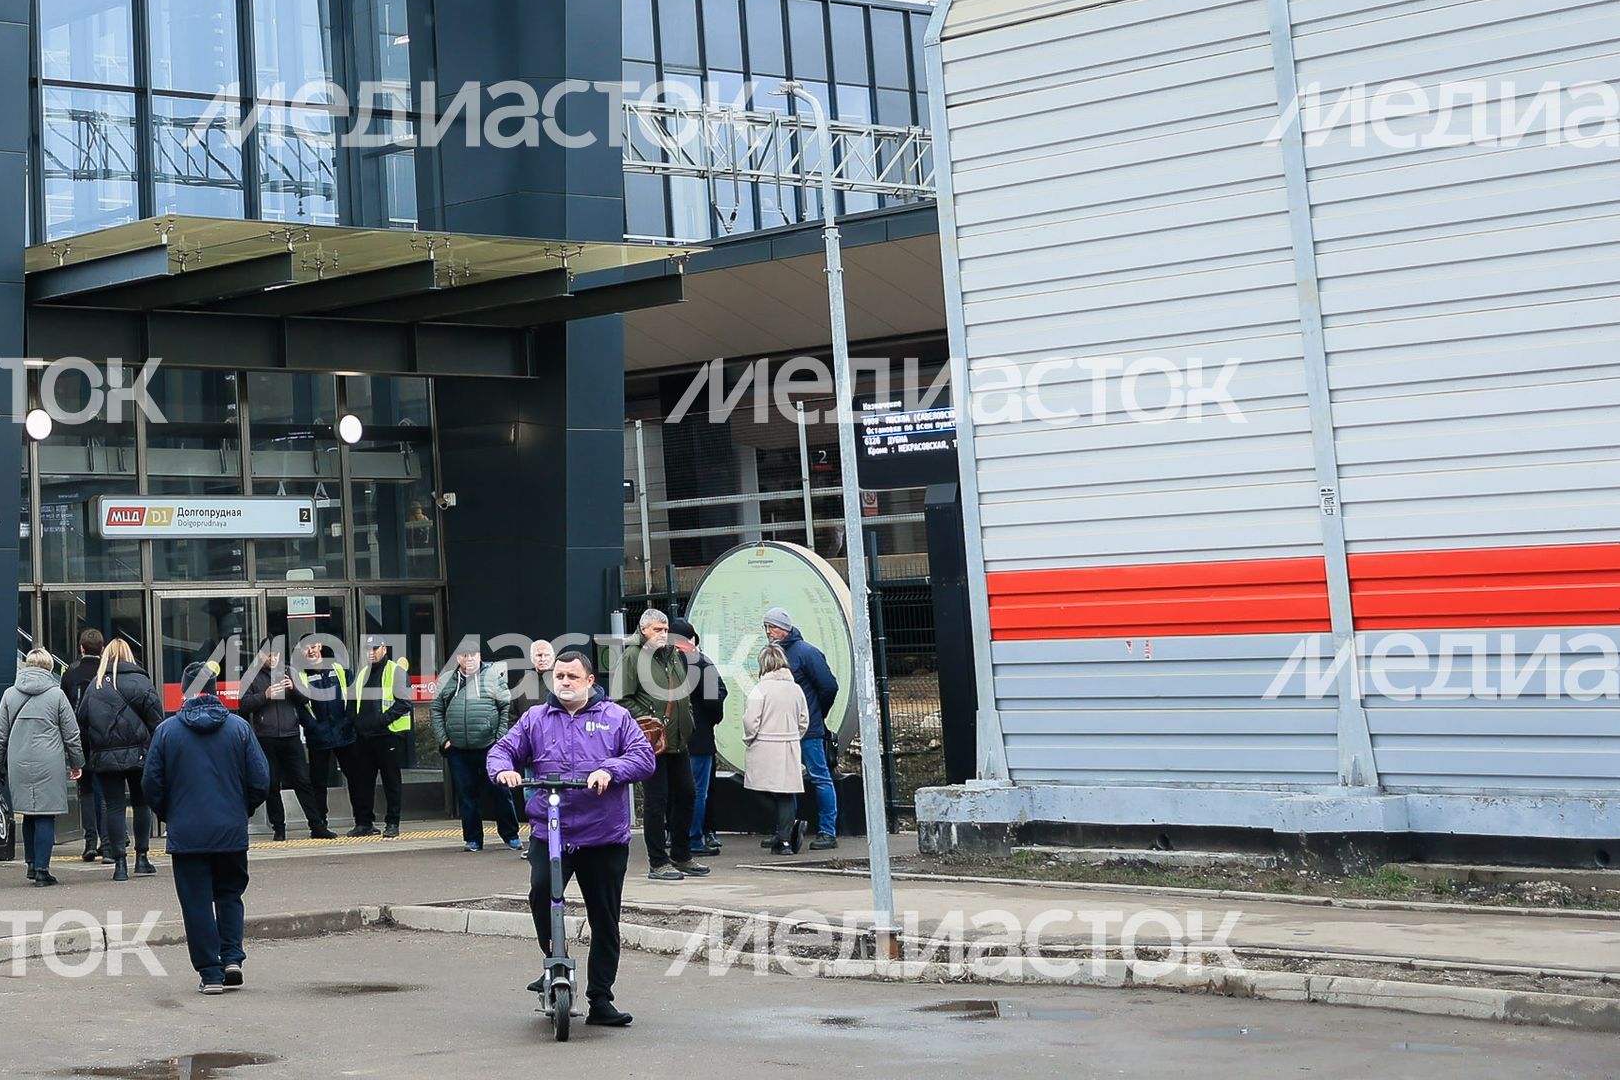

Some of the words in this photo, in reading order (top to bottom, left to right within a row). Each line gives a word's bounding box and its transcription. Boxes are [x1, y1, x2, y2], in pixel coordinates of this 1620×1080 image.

[818, 450, 828, 464] 2
[111, 509, 140, 523] МЦД
[151, 510, 169, 523] D1
[177, 507, 242, 519] Долгопрудная
[302, 510, 308, 520] 2
[178, 519, 227, 528] Dolgoprudnaya
